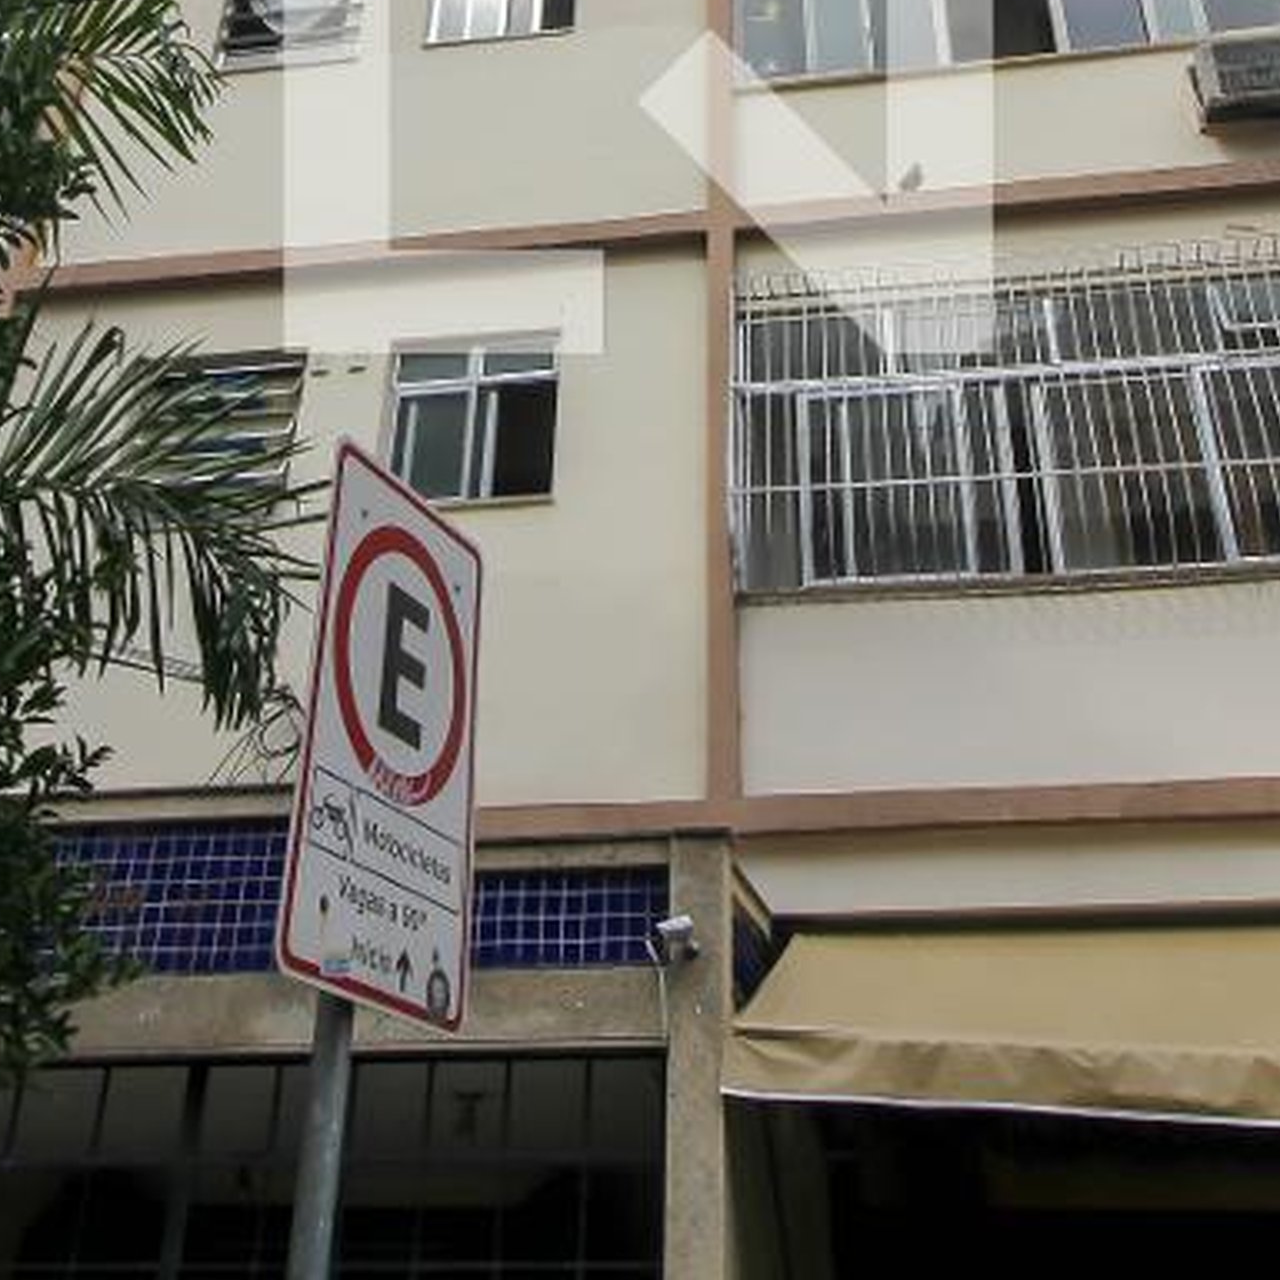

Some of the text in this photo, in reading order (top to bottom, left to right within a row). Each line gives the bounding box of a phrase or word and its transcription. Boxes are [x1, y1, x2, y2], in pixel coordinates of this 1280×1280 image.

[377, 581, 431, 752] E
[363, 819, 451, 885] Motocicletas
[339, 875, 385, 916] Vagas
